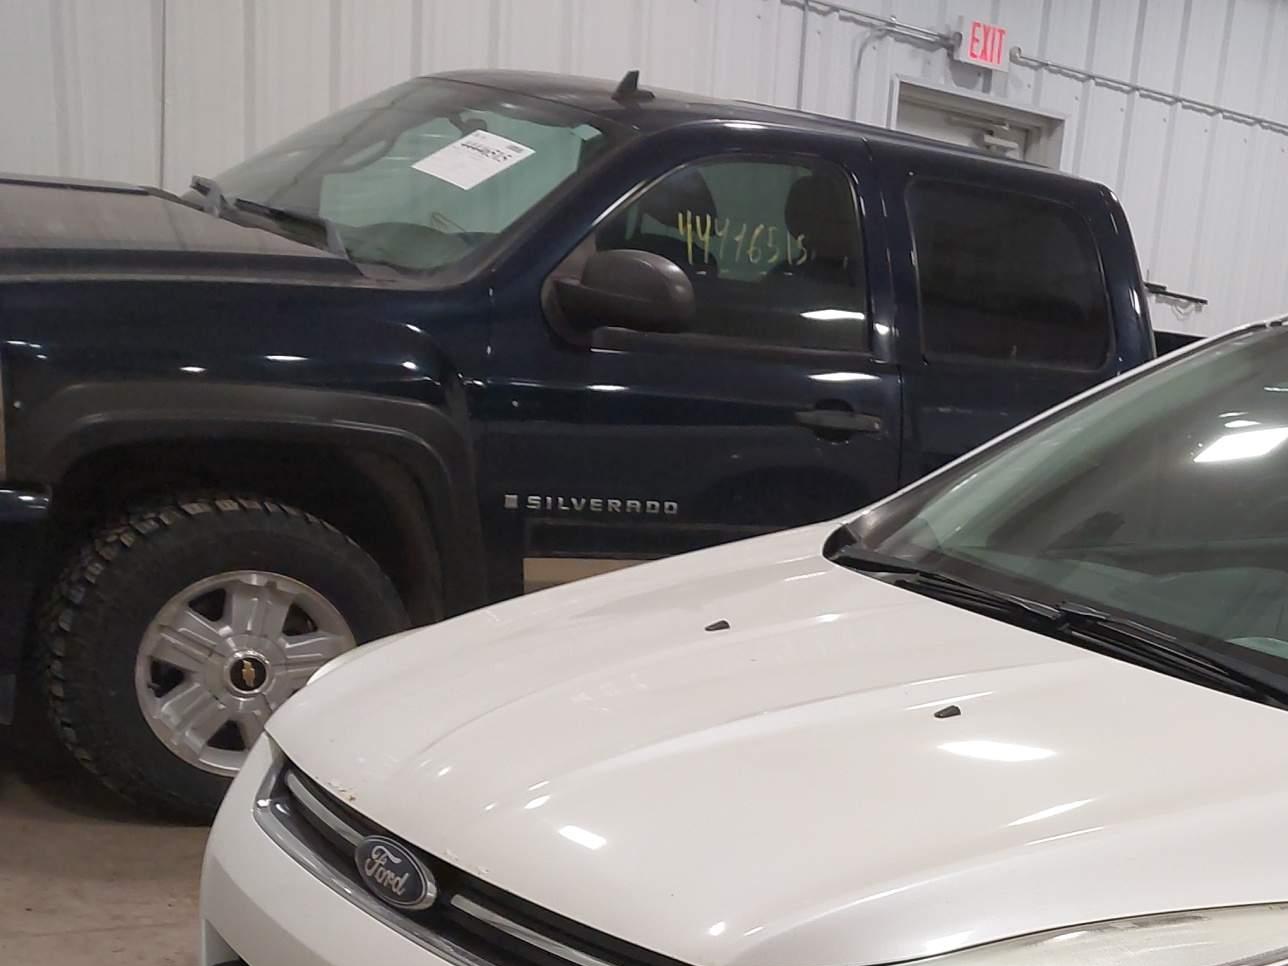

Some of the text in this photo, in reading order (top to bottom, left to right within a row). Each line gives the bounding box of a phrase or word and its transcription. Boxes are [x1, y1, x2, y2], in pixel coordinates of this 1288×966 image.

[968, 20, 1006, 65] EXIT
[525, 494, 679, 515] SILVERADO
[364, 844, 411, 896] Ford
